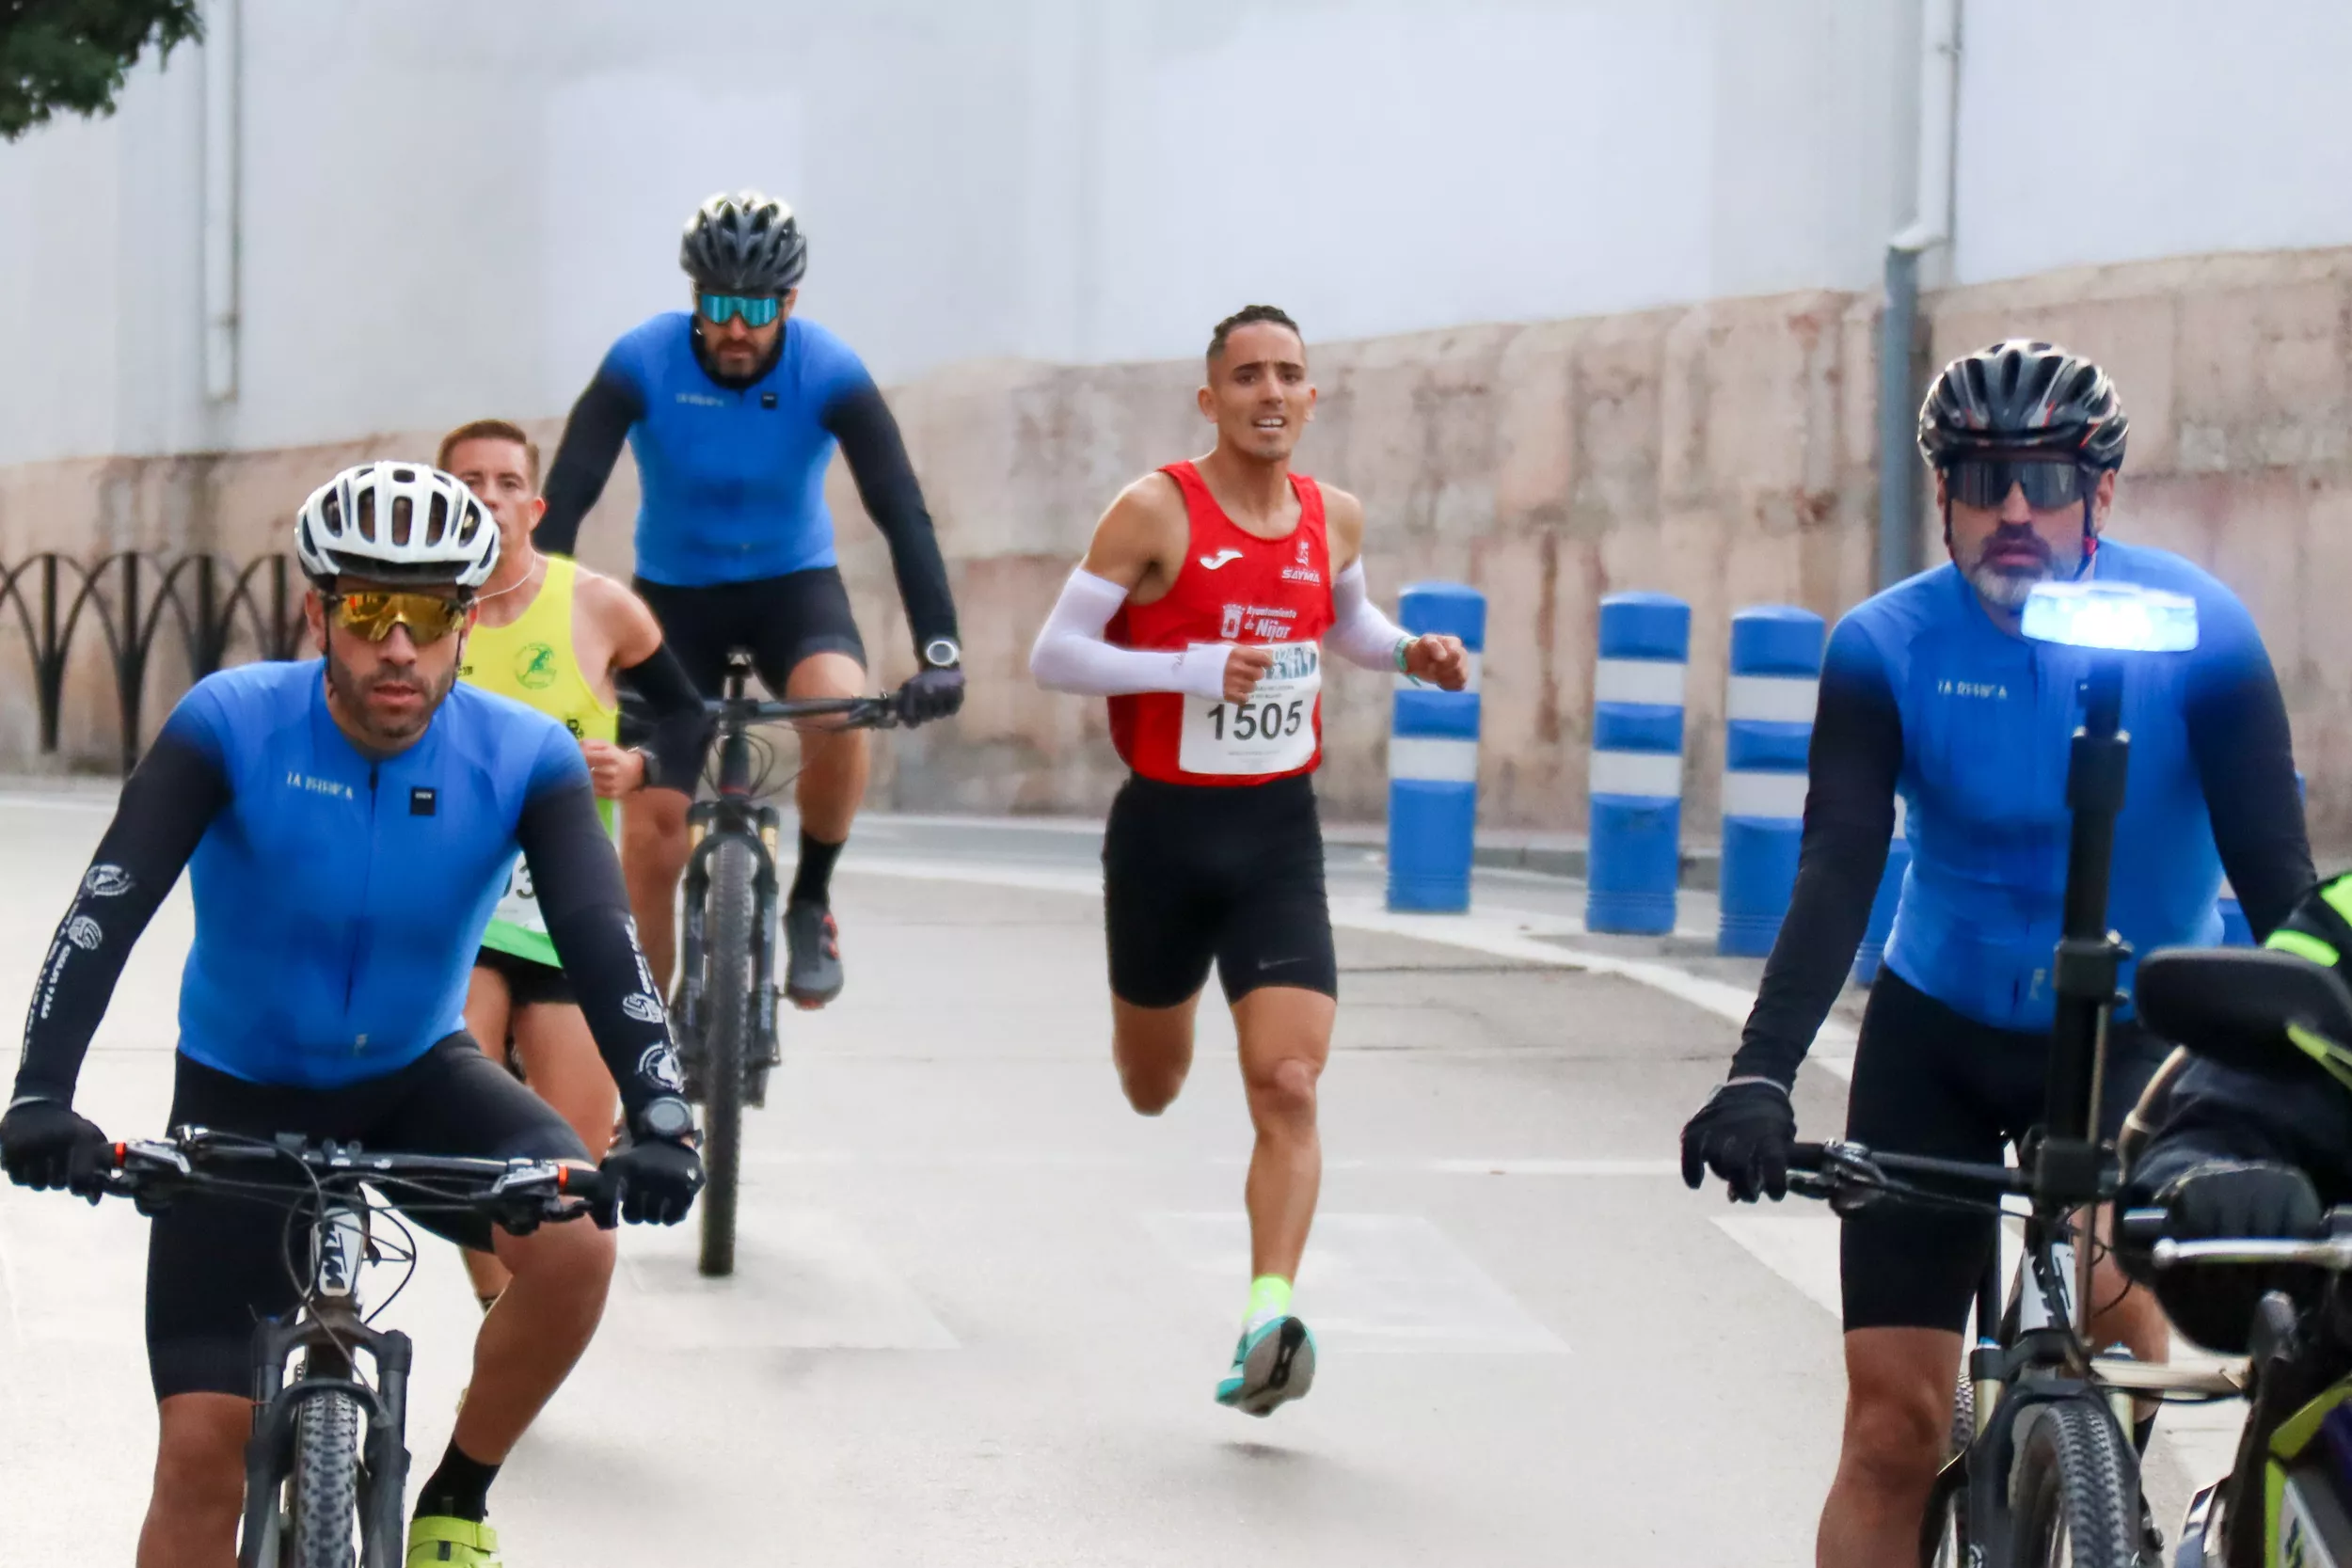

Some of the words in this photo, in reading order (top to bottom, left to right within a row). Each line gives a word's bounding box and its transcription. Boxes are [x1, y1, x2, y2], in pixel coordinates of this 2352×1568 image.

[1281, 569, 1319, 582] SAYMA
[1246, 606, 1296, 619] Ayuntamiento
[1208, 701, 1302, 740] 1505
